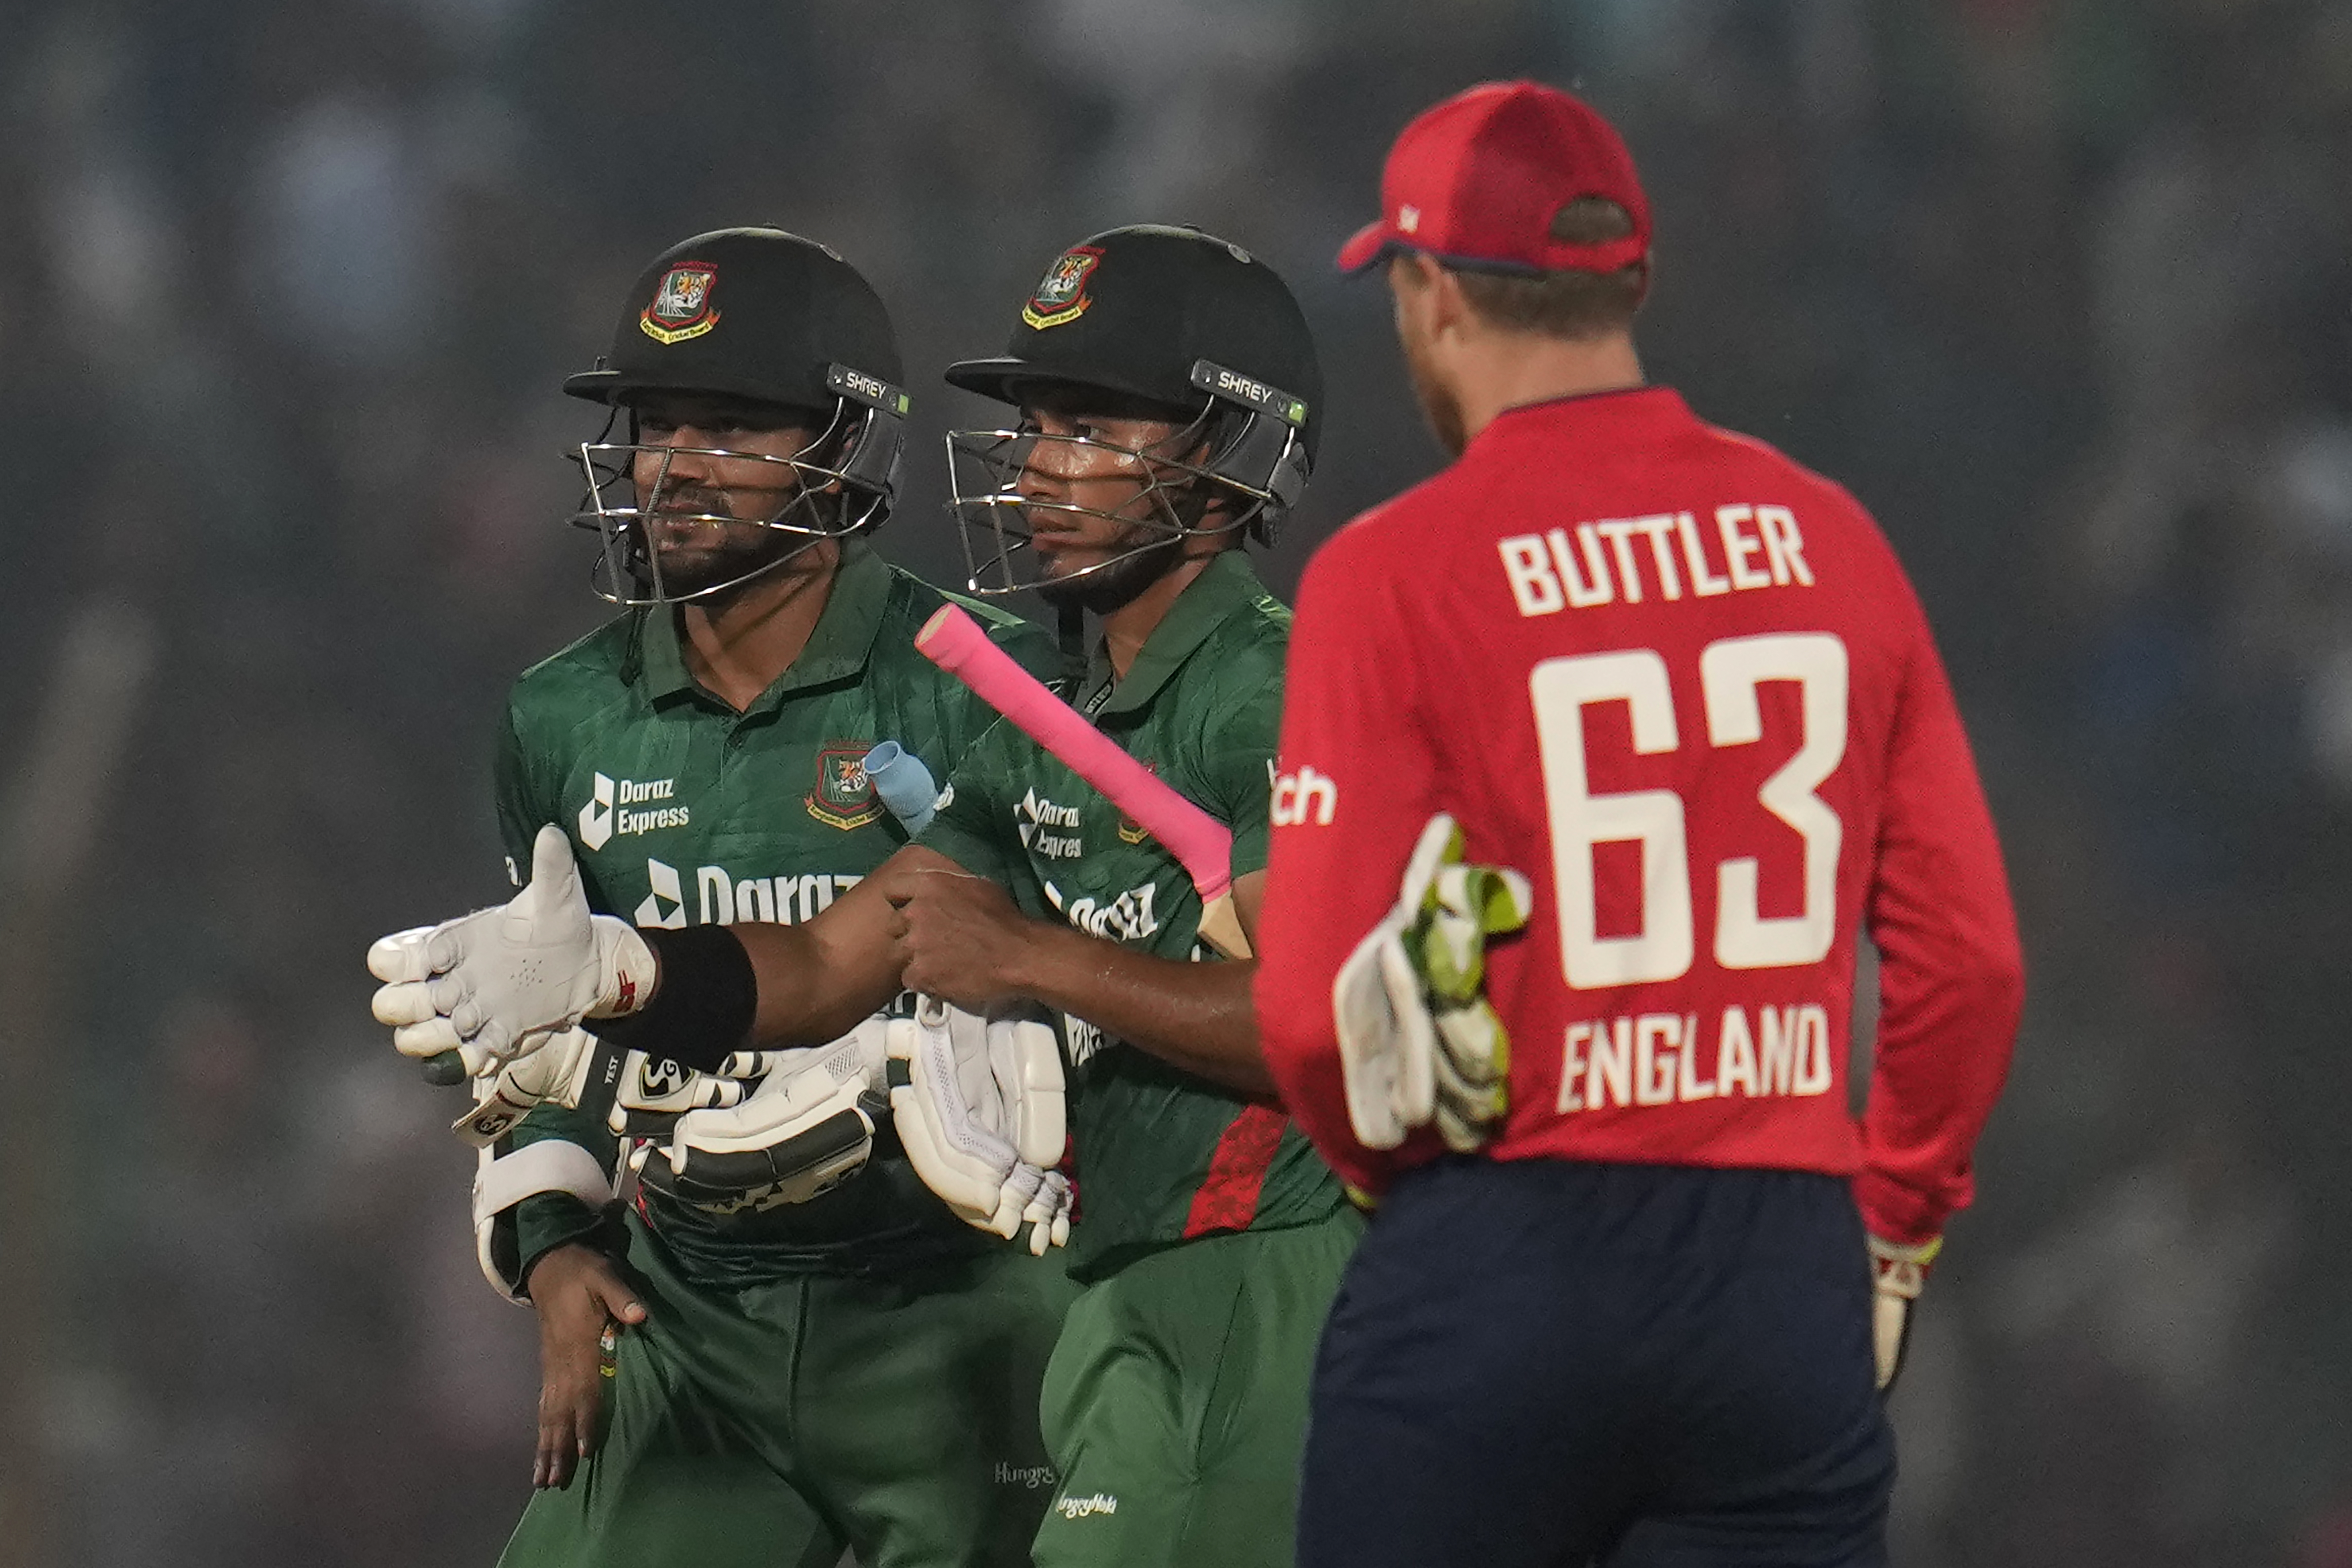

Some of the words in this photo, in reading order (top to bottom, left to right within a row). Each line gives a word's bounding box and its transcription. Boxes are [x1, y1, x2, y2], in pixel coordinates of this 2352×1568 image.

[846, 372, 886, 399] SHREY
[1218, 371, 1272, 404] SHREY
[1497, 503, 1815, 617] BUTTLER
[619, 778, 673, 804] Daraz
[618, 806, 689, 835] Express
[1529, 631, 1849, 990] 63
[604, 1055, 618, 1084] TEST
[1556, 1003, 1832, 1115] ENGLAND
